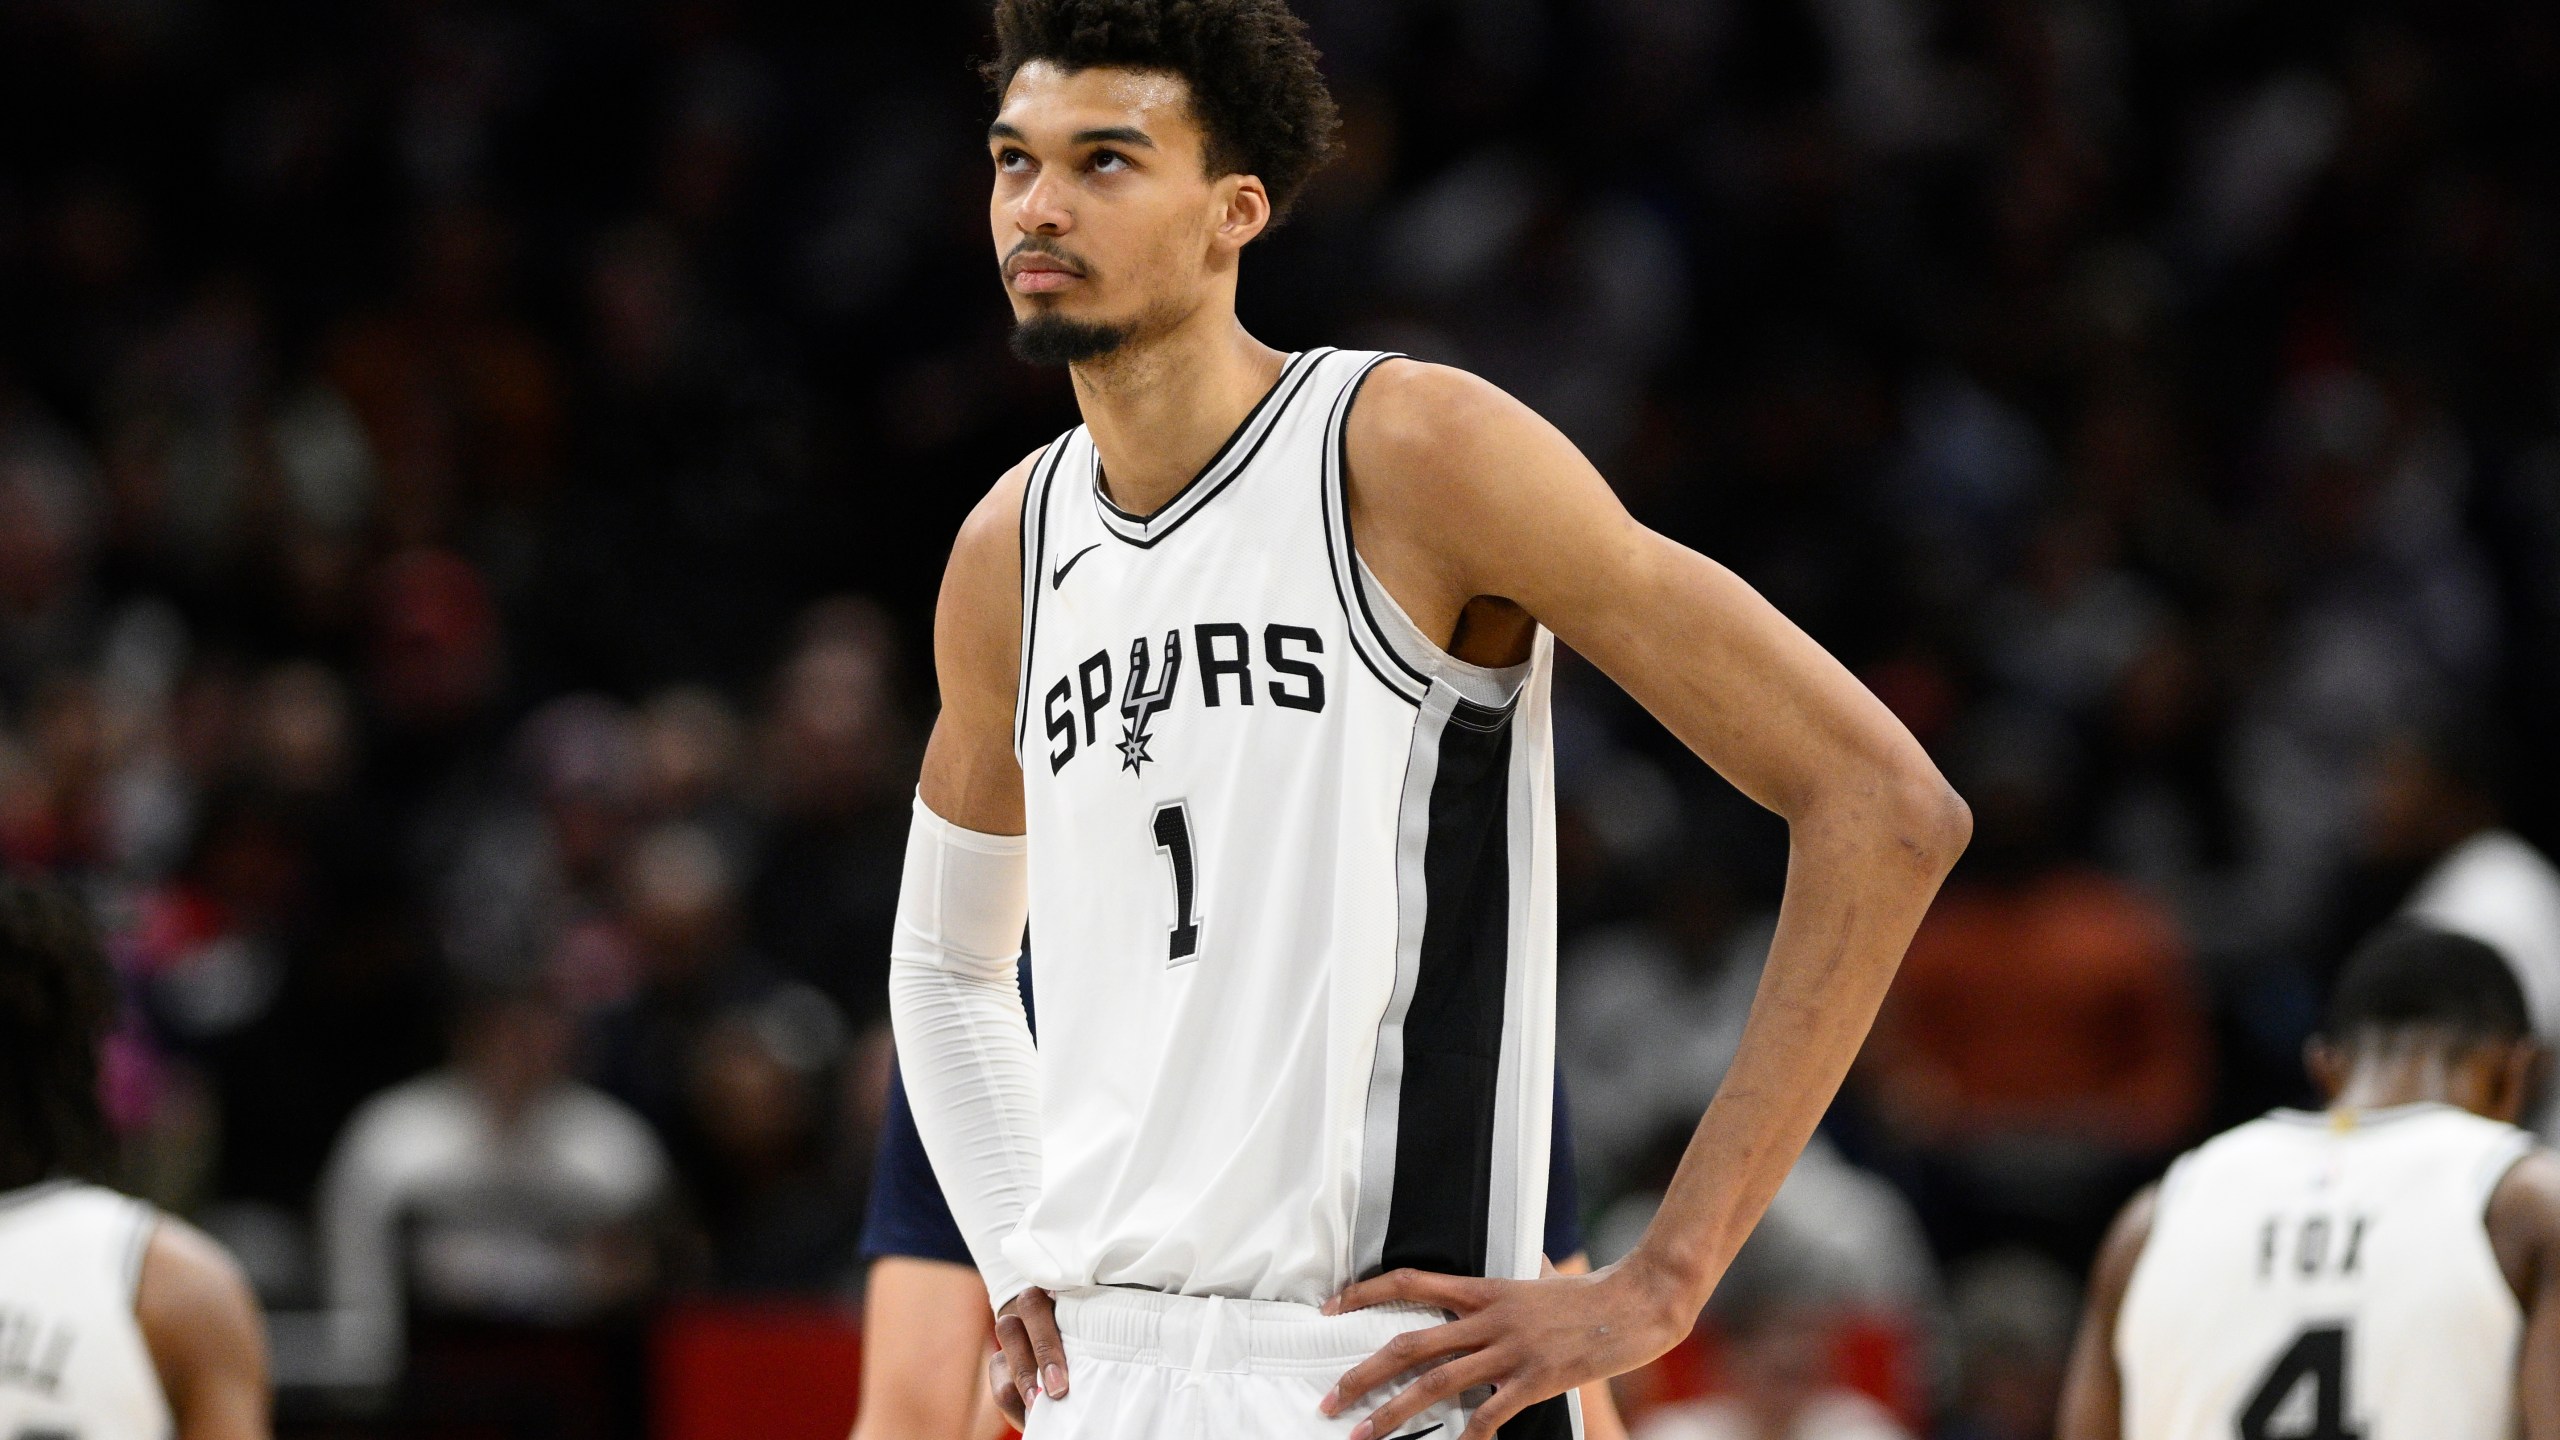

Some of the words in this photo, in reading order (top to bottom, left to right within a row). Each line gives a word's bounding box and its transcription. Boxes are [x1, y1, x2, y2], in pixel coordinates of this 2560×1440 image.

[1045, 622, 1325, 778] SPURS
[1149, 797, 1204, 970] 1
[2257, 1212, 2372, 1281] FOX
[2229, 1316, 2372, 1440] 4
